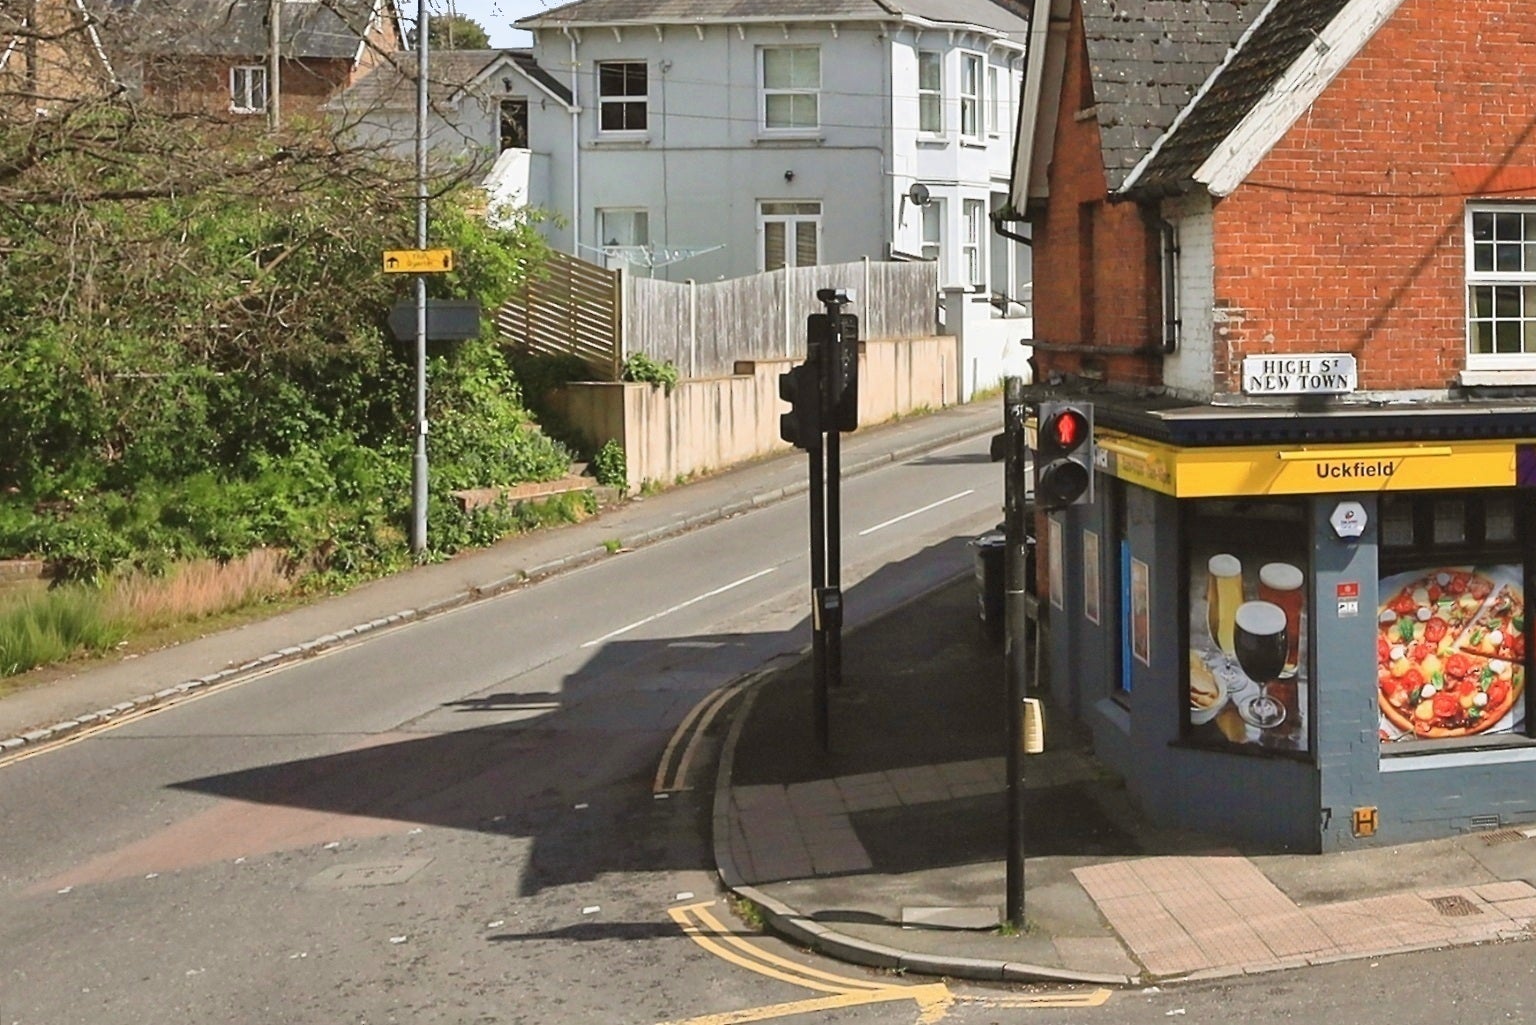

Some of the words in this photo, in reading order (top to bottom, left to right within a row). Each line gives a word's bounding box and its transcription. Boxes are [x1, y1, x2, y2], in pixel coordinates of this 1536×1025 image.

[1264, 360, 1311, 374] HIGH
[1250, 376, 1289, 390] NEW
[1300, 374, 1348, 389] TOWN
[1316, 461, 1394, 478] Uckfield
[1356, 809, 1374, 833] H
